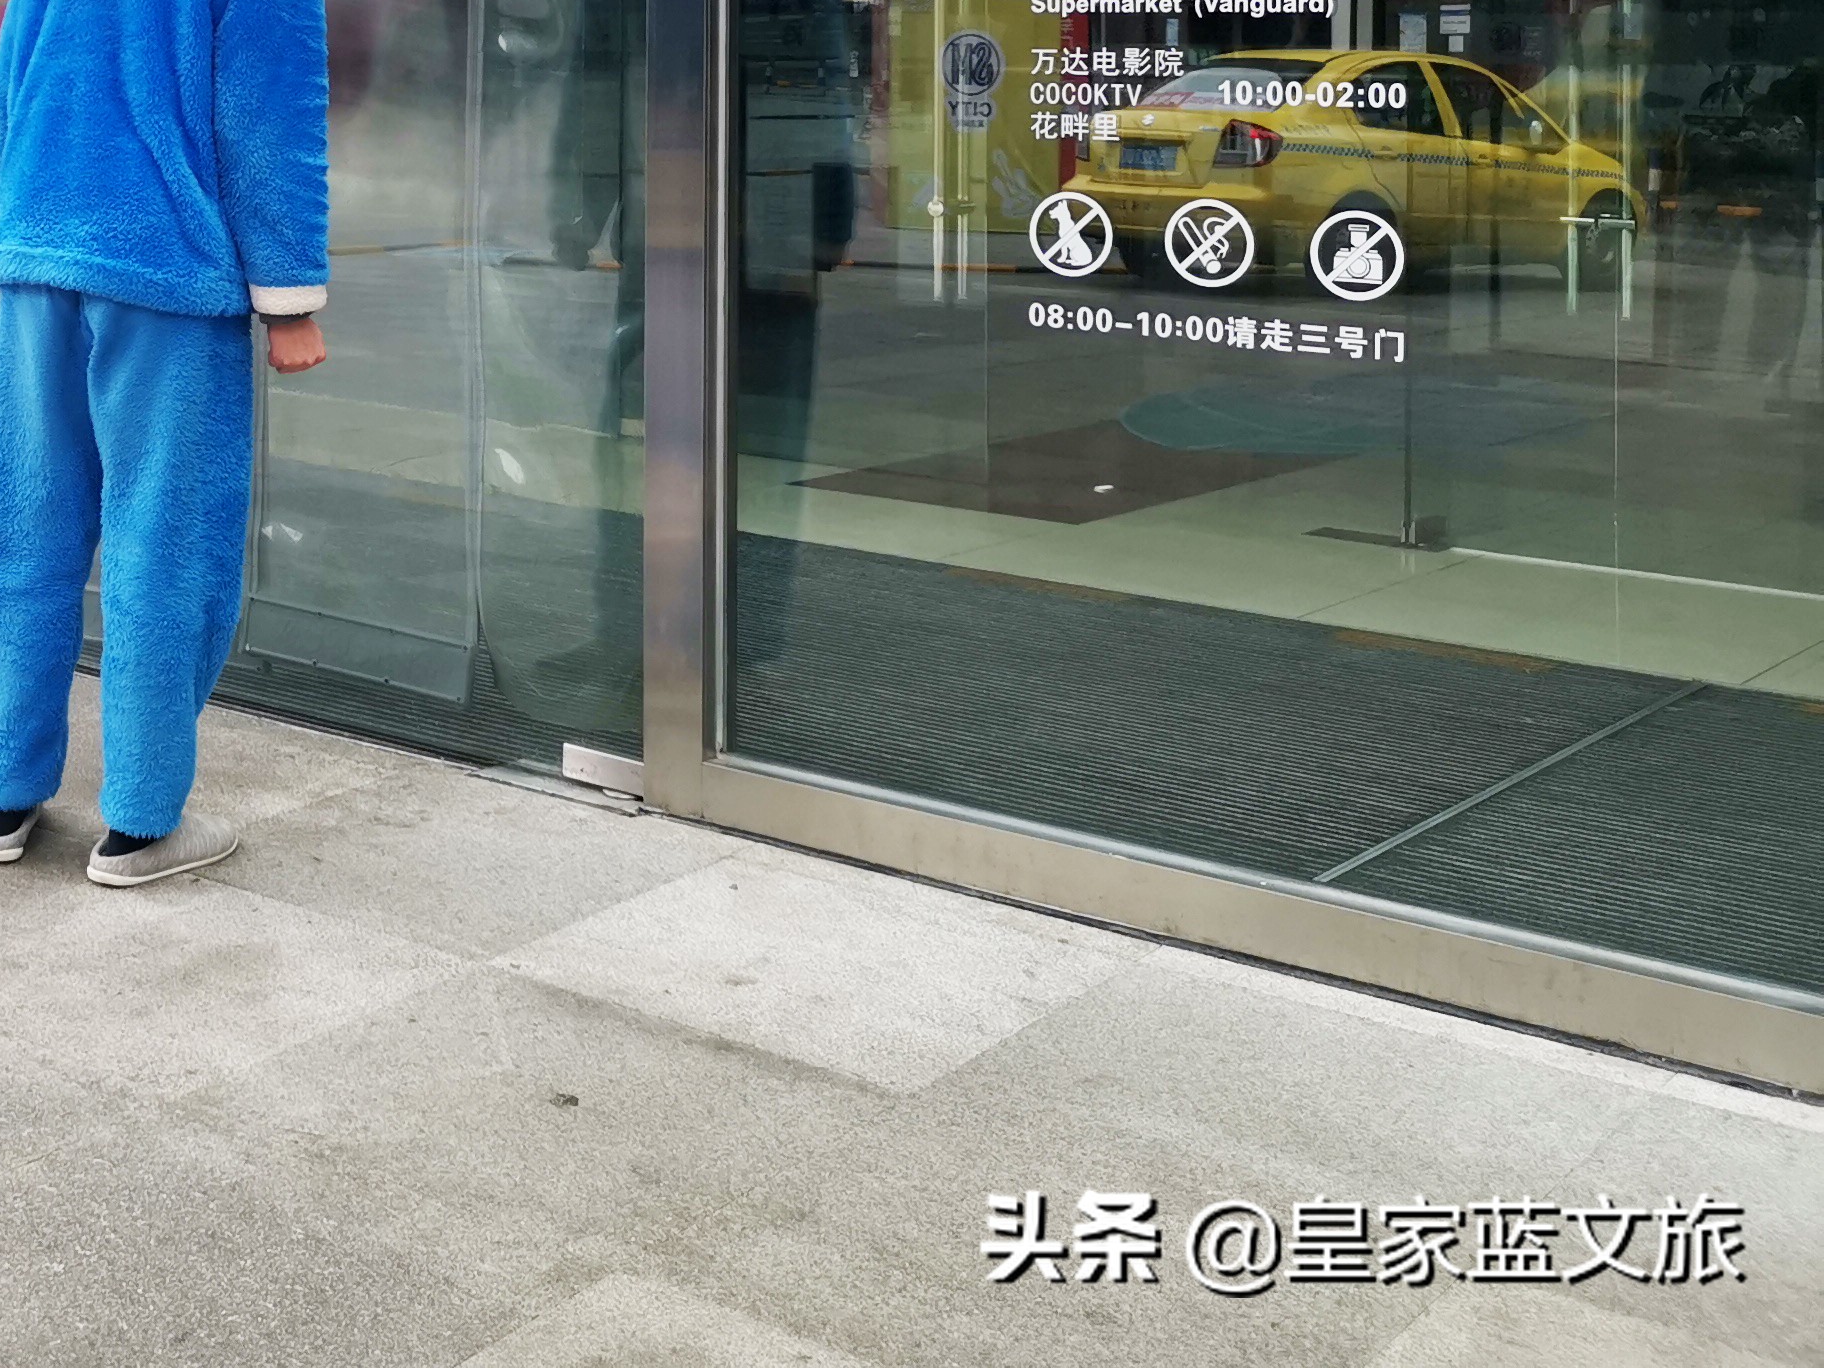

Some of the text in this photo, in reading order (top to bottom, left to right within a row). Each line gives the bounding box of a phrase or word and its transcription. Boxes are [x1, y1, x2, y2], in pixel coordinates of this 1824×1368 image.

[1030, 46, 1185, 78] 万达电影院
[1030, 80, 1407, 111] COCOKTV 10:00-02:00
[1030, 112, 1121, 143] 花畔里
[1028, 302, 1405, 363] 08:00-10:00请走三号门
